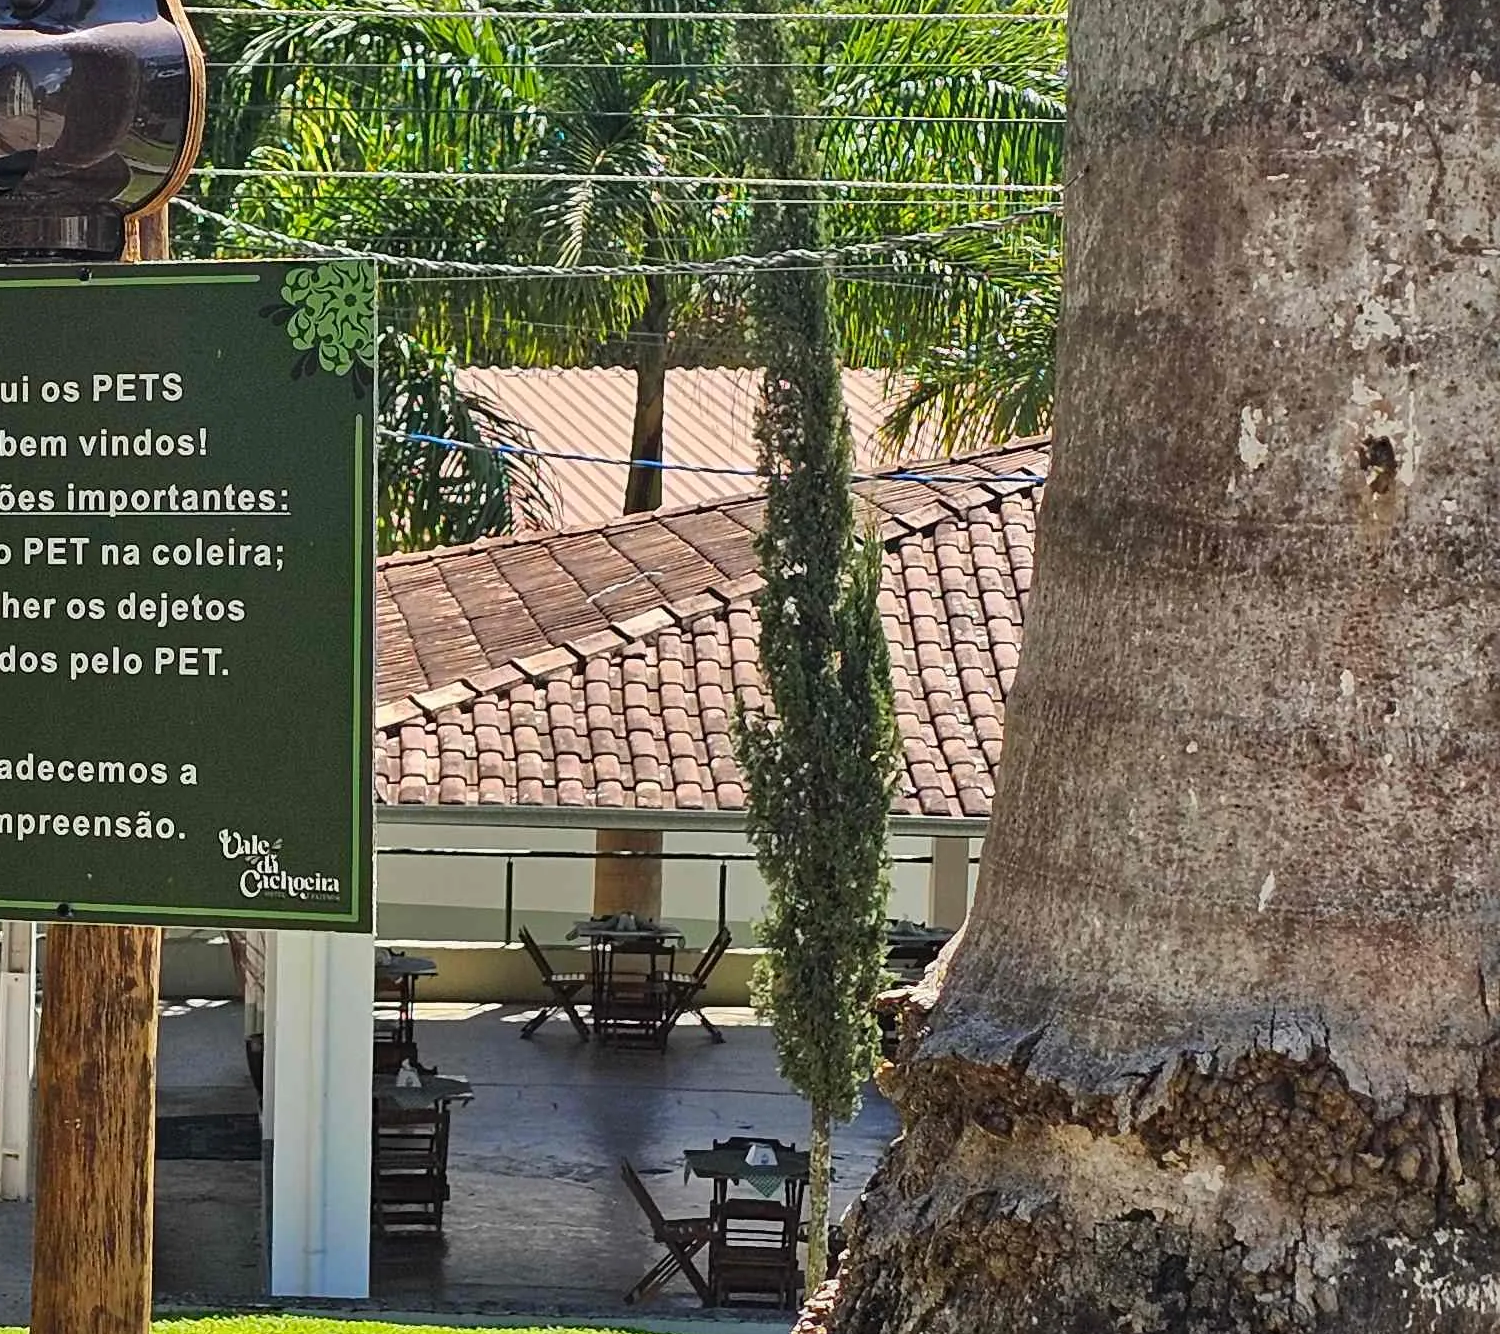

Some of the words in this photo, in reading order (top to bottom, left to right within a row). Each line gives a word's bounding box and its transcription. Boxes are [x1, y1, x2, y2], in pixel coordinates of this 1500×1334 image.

[41, 381, 80, 403] os
[92, 372, 183, 402] PETS
[0, 429, 67, 457] bem
[78, 427, 207, 457] vindos!
[67, 482, 288, 517] importantes:
[24, 537, 90, 566] PET
[101, 544, 141, 566] na
[152, 537, 284, 572] coleira;
[66, 598, 106, 620] os
[117, 591, 245, 628] dejetos
[70, 646, 143, 681] pelo
[154, 647, 229, 676] PET.
[179, 763, 198, 785] a
[218, 828, 270, 859] Vale
[239, 869, 340, 900] Cachoeira
